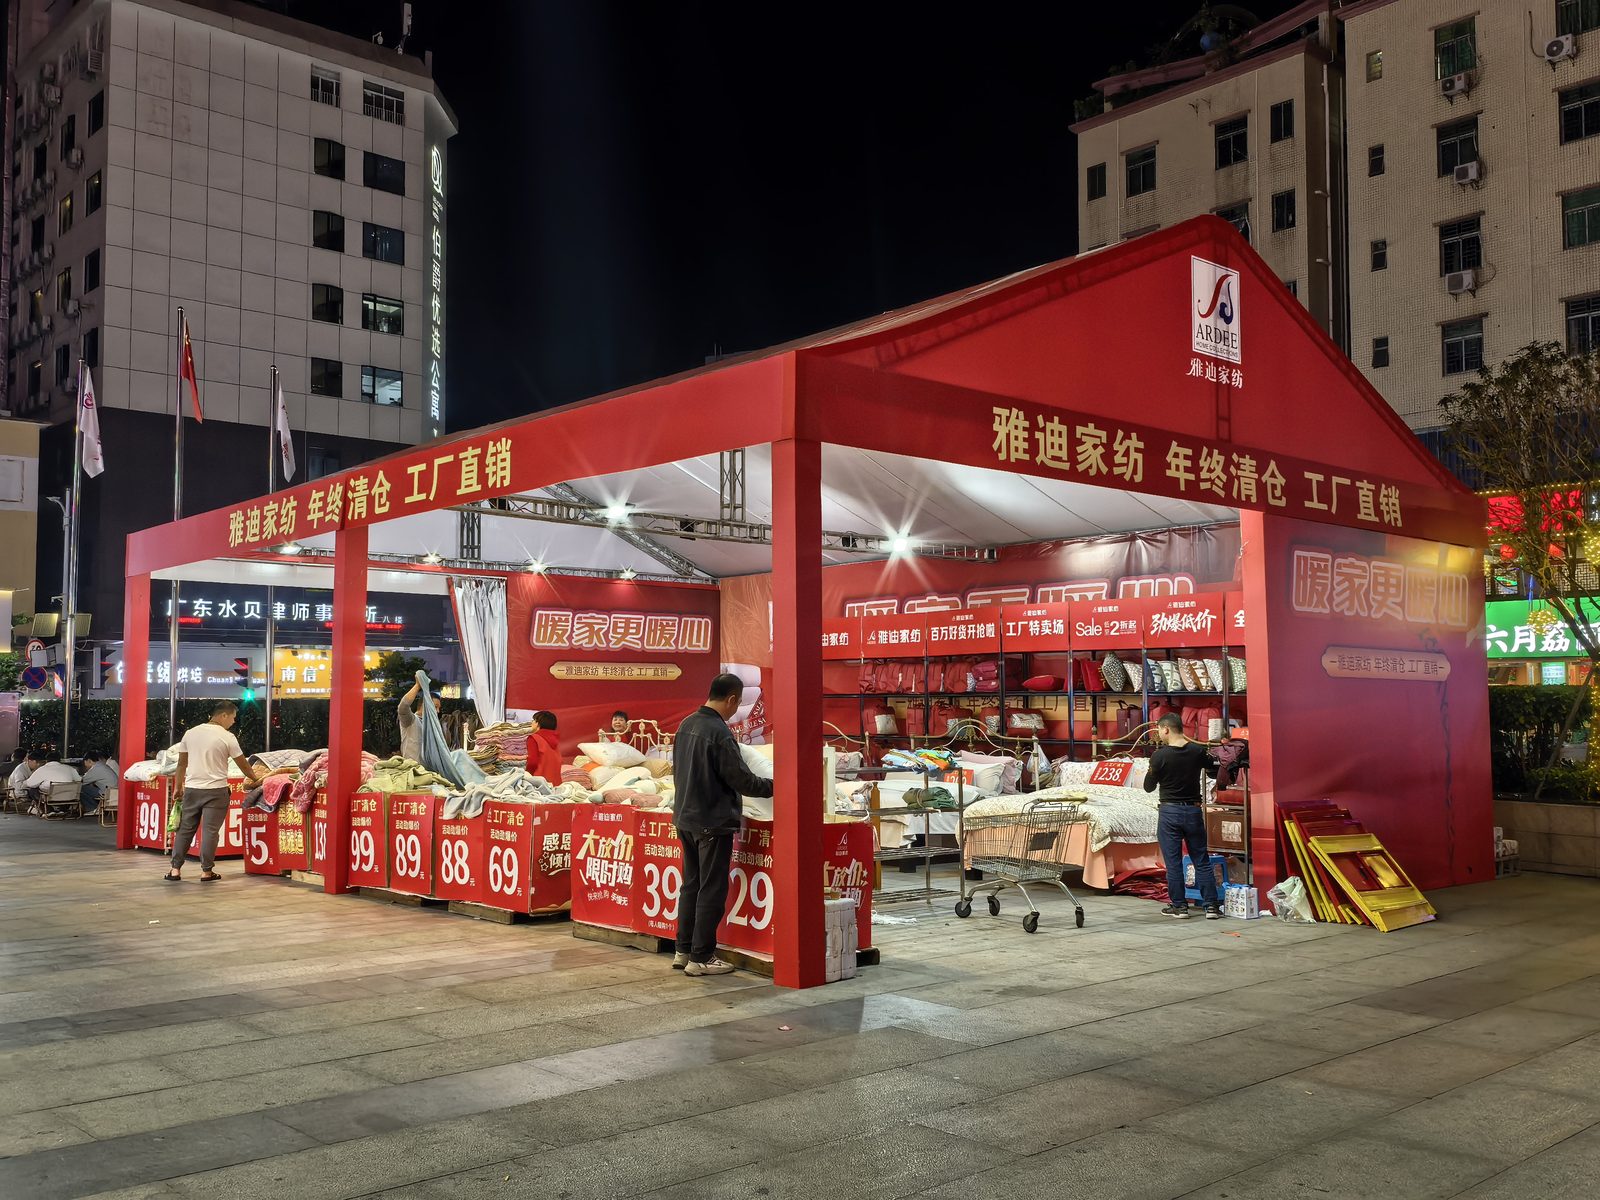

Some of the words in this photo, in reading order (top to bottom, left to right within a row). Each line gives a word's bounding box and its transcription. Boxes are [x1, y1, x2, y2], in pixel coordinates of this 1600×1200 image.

[1196, 322, 1238, 350] ARDEE
[1196, 341, 1209, 350] HOME
[1210, 344, 1239, 358] COLLECTIONS
[1186, 358, 1243, 388] 雅迪家纺
[992, 406, 1145, 483] 雅迪家纺
[1165, 440, 1287, 508] 年终清仓
[1304, 471, 1403, 528] 工厂直销
[228, 496, 297, 548] 雅迪家纺
[307, 470, 391, 529] 年终清仓
[404, 437, 512, 504] 工厂直销
[1293, 550, 1469, 627] 暖家更暖心
[167, 598, 377, 624] 广东水贝律师事所
[1150, 608, 1217, 638] 劲爆低价
[533, 609, 712, 651] 暖家更暖心
[878, 629, 921, 645] 雅迪家纺
[930, 623, 996, 642] 百万好货开抢啦
[1006, 618, 1065, 637] 工厂特卖场
[1075, 617, 1102, 637] Sale
[565, 665, 600, 678] 雅迪家纺
[602, 666, 634, 678] 年终清仓
[636, 667, 668, 679] 工厂直销
[1097, 767, 1123, 781] 238
[353, 798, 377, 813] 工厂清仓
[397, 801, 427, 816] 工厂清仓
[493, 809, 525, 827] 工厂清仓
[139, 802, 160, 841] 99
[250, 825, 269, 865] 5
[351, 830, 375, 872] 99
[542, 832, 572, 852] 感恩
[576, 828, 634, 862] 大放价
[644, 843, 682, 859] 活动劲爆价
[738, 827, 774, 848] 工厂清
[395, 833, 421, 878] 89
[441, 838, 470, 885] 88
[731, 849, 774, 869] 活动劲爆价
[489, 845, 519, 896] 69
[586, 856, 634, 888] 限时购
[642, 862, 683, 921] 39
[726, 867, 774, 930] 29
